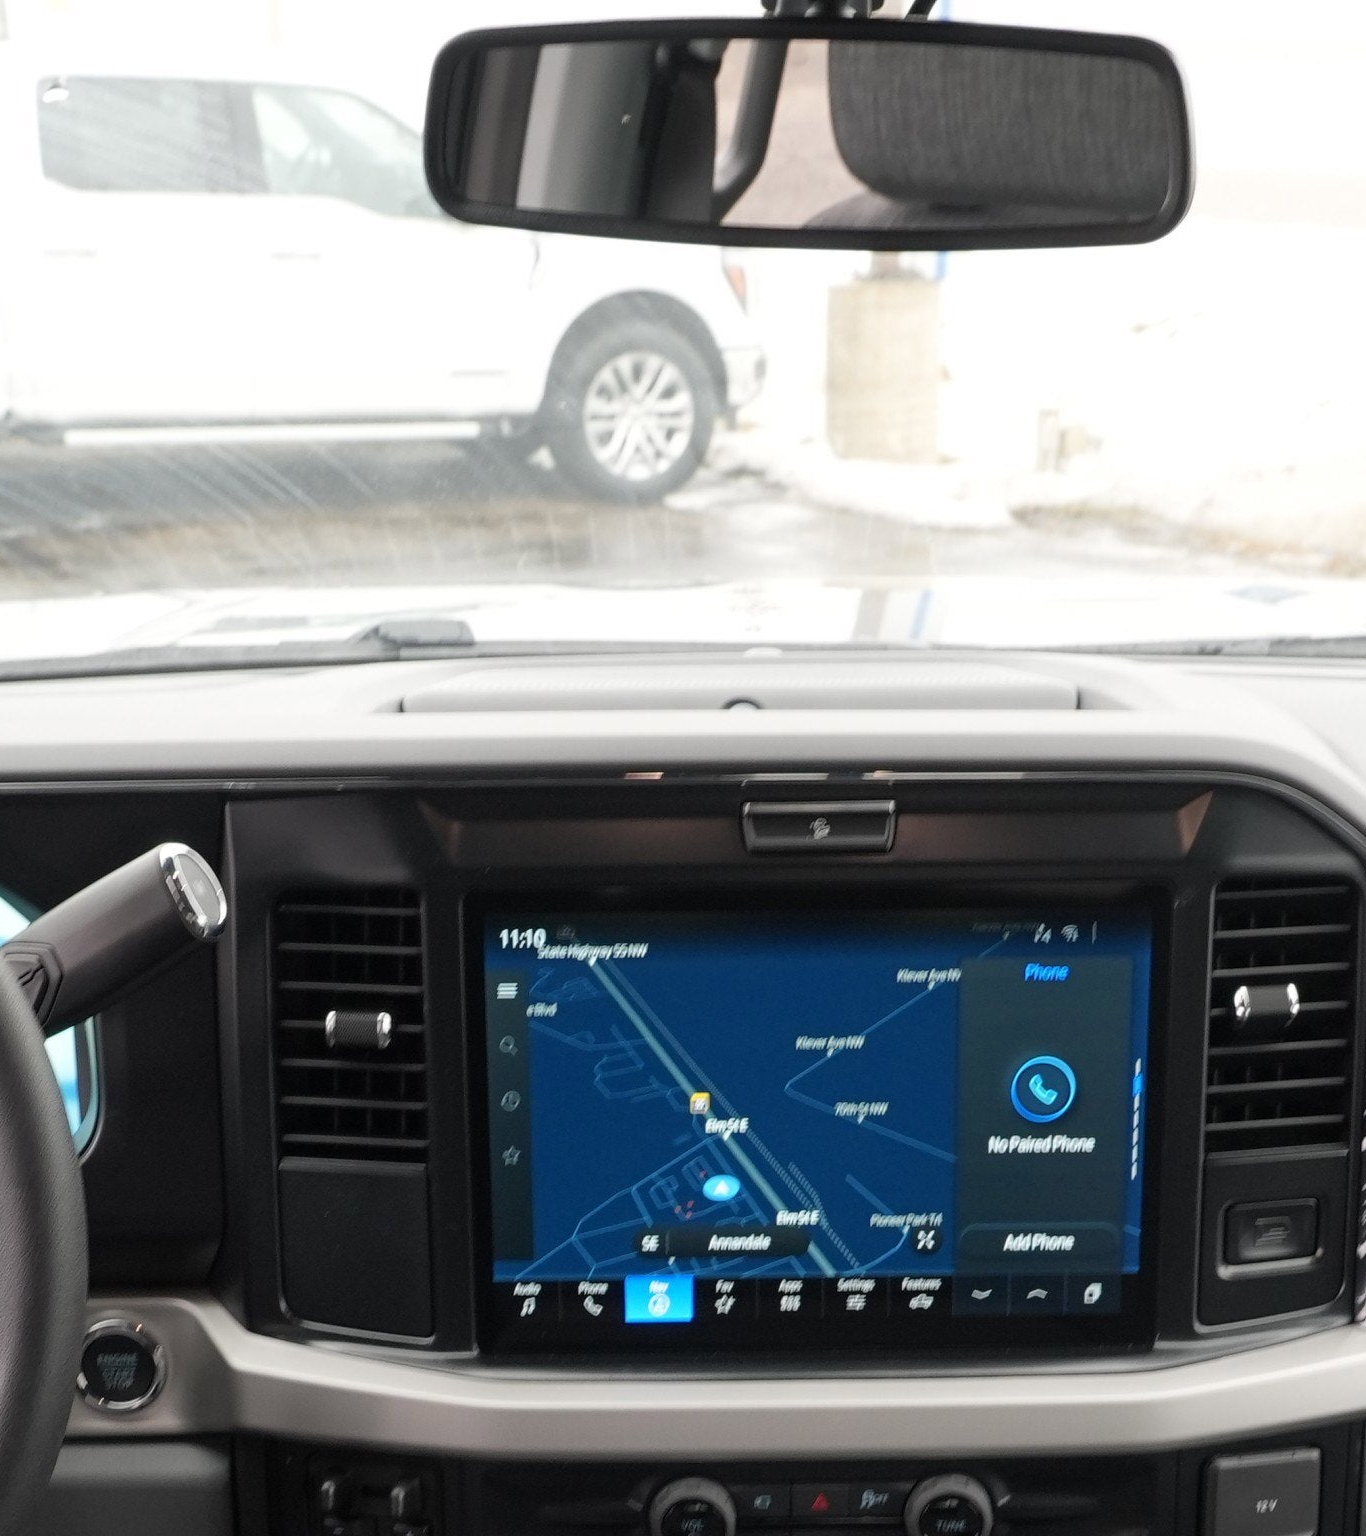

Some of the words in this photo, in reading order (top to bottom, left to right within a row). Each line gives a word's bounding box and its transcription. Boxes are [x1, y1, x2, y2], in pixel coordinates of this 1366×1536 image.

[499, 927, 546, 949] 11:10
[537, 943, 567, 959] State
[567, 943, 612, 961] Highway
[1025, 963, 1071, 981] Phone
[705, 1117, 726, 1133] Elm
[738, 1117, 749, 1133] E
[988, 1135, 1008, 1153] No
[1009, 1135, 1051, 1153] Paired
[1052, 1135, 1095, 1153] Phone
[776, 1209, 797, 1225] Elm
[796, 1209, 810, 1225] St
[809, 1209, 820, 1225] E
[708, 1233, 771, 1251] Annandale
[1003, 1233, 1031, 1251] Add
[1032, 1233, 1075, 1251] Phone
[513, 1281, 541, 1296] Audio
[577, 1281, 608, 1296] Phone
[648, 1280, 669, 1293] Nav
[715, 1279, 734, 1293] Fav
[777, 1279, 803, 1294] Apps
[837, 1277, 876, 1293] Settings
[901, 1276, 942, 1292] Features
[936, 1519, 968, 1533] TUNE
